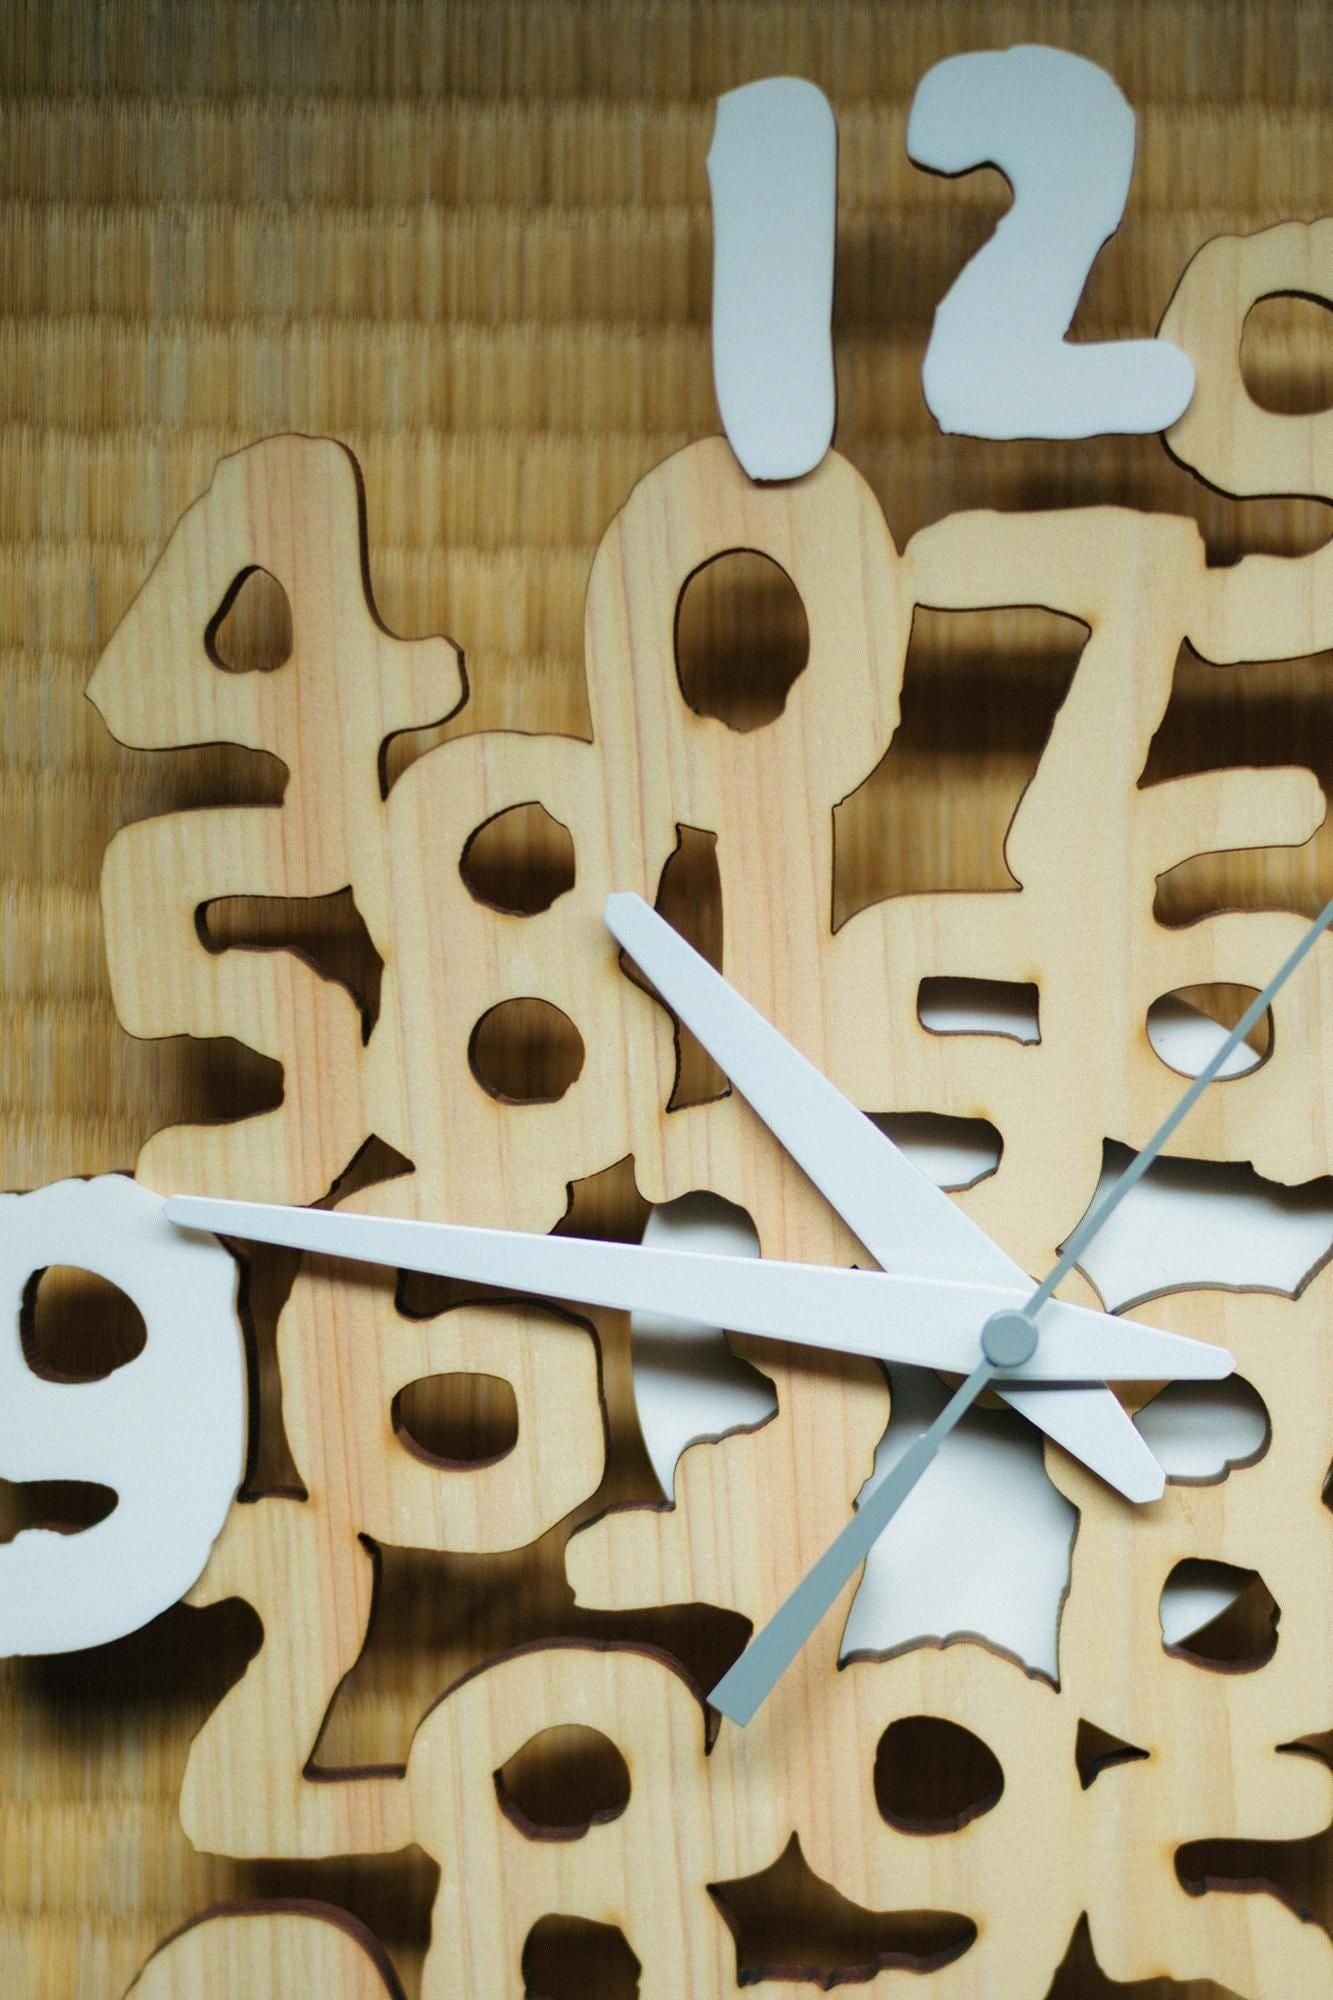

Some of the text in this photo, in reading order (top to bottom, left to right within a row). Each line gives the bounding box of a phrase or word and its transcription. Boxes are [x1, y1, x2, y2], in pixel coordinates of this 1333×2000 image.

[706, 43, 1197, 483] 12
[85, 432, 469, 840] 4
[903, 504, 1208, 895] 7
[100, 800, 387, 1210] 5
[380, 729, 665, 1235] 8
[0, 1171, 248, 1658] 9
[275, 1180, 607, 1555] 6
